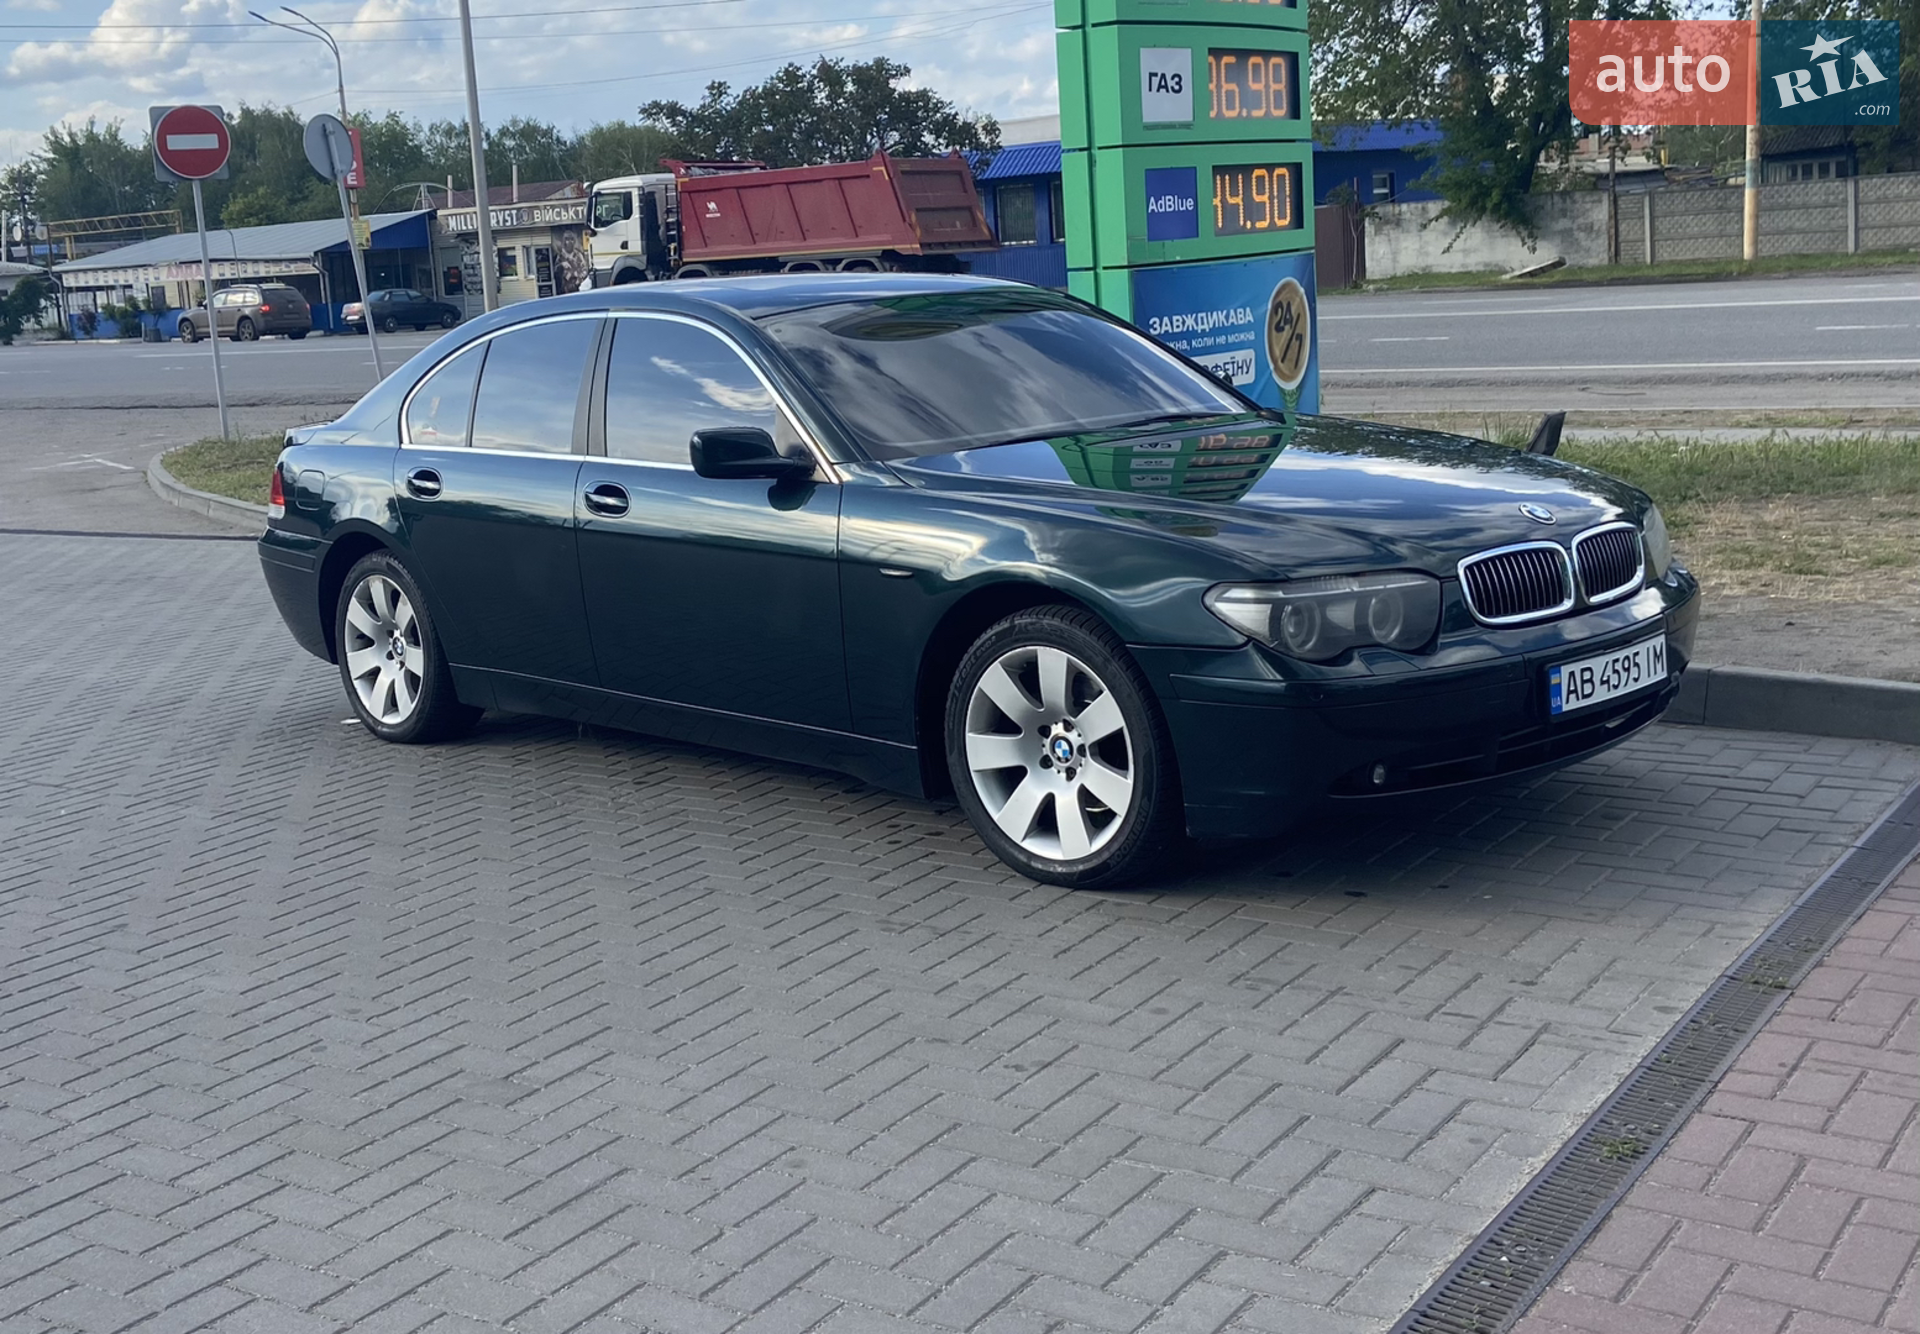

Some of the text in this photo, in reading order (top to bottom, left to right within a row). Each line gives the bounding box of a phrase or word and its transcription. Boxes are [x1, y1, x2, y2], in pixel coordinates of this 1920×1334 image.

[1147, 72, 1183, 95] ГАЗ
[1147, 195, 1194, 214] AdBlue
[448, 209, 518, 232] MILLIRYST
[1149, 307, 1255, 335] ЗАВЖДИКАВА
[1191, 337, 1215, 349] коли
[1216, 335, 1227, 345] не
[1227, 330, 1256, 343] можна
[1565, 641, 1665, 705] AB 4595 IM
[1551, 696, 1562, 708] UA
